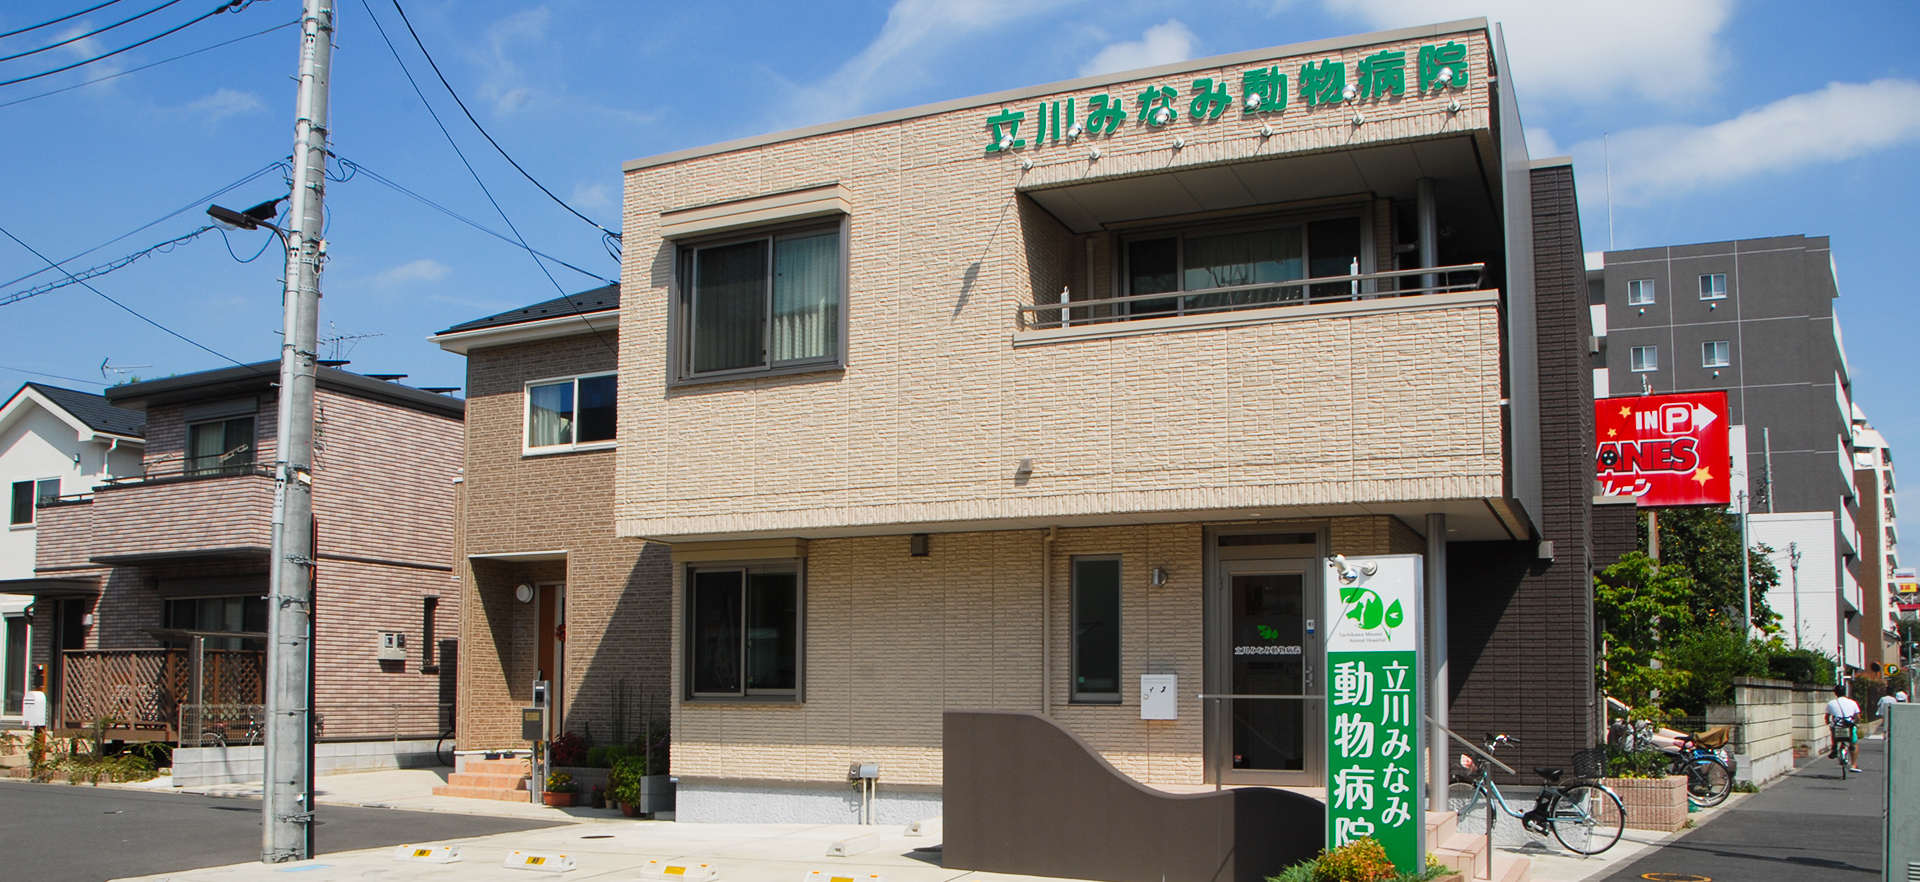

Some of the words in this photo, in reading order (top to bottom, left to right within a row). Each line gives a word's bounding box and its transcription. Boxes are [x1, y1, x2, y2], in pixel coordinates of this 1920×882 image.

[985, 41, 1469, 153] 立川みなみ動物病院
[1635, 410, 1658, 430] IN
[1665, 407, 1689, 432] P
[1602, 478, 1652, 497] レーン
[1334, 660, 1375, 848] 動物病院
[1381, 660, 1411, 828] 立川みなみ
